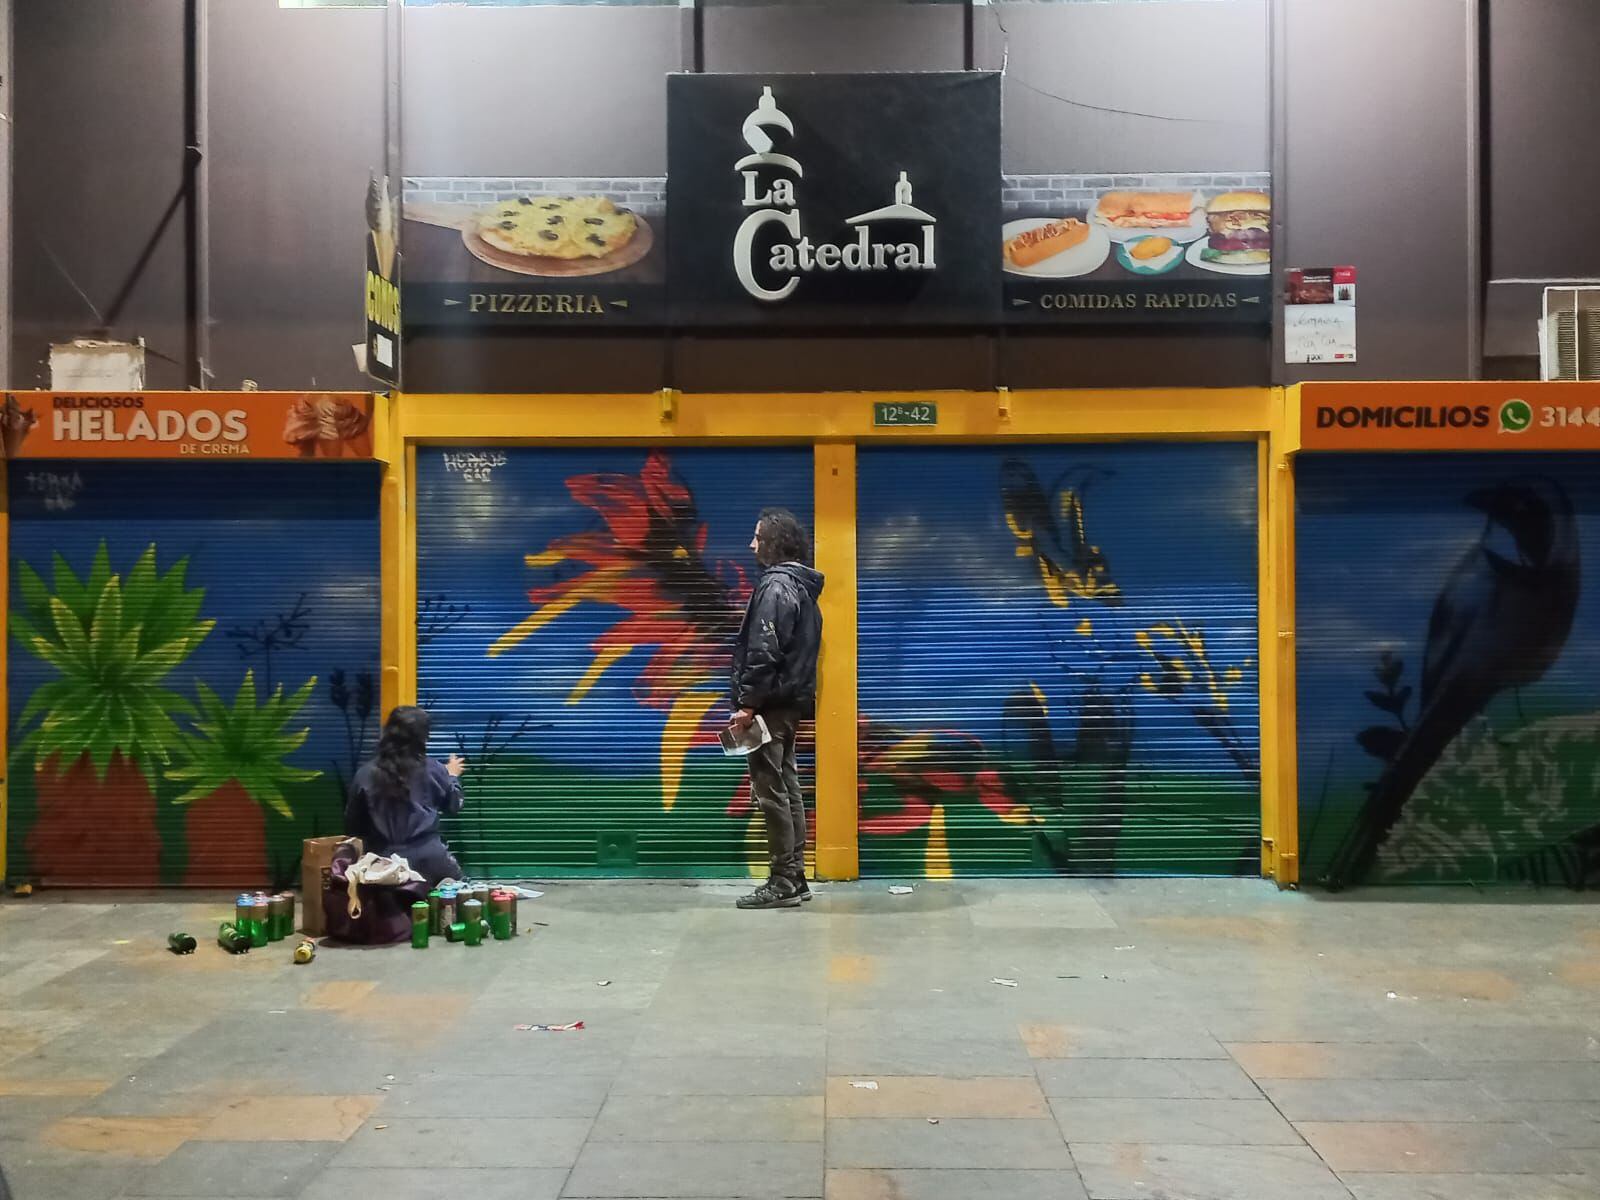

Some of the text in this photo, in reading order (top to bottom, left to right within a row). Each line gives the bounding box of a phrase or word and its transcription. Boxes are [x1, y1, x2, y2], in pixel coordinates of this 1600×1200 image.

[741, 170, 796, 206] La
[733, 208, 937, 301] Catedral
[469, 294, 604, 314] PIZZERIA
[1040, 292, 1238, 309] COMIDAS RAPIDAS
[52, 396, 144, 410] DELICIOSOS
[53, 410, 248, 442] HELADOS
[1316, 405, 1490, 428] DOMICILIOS
[180, 443, 250, 455] DE CREMA
